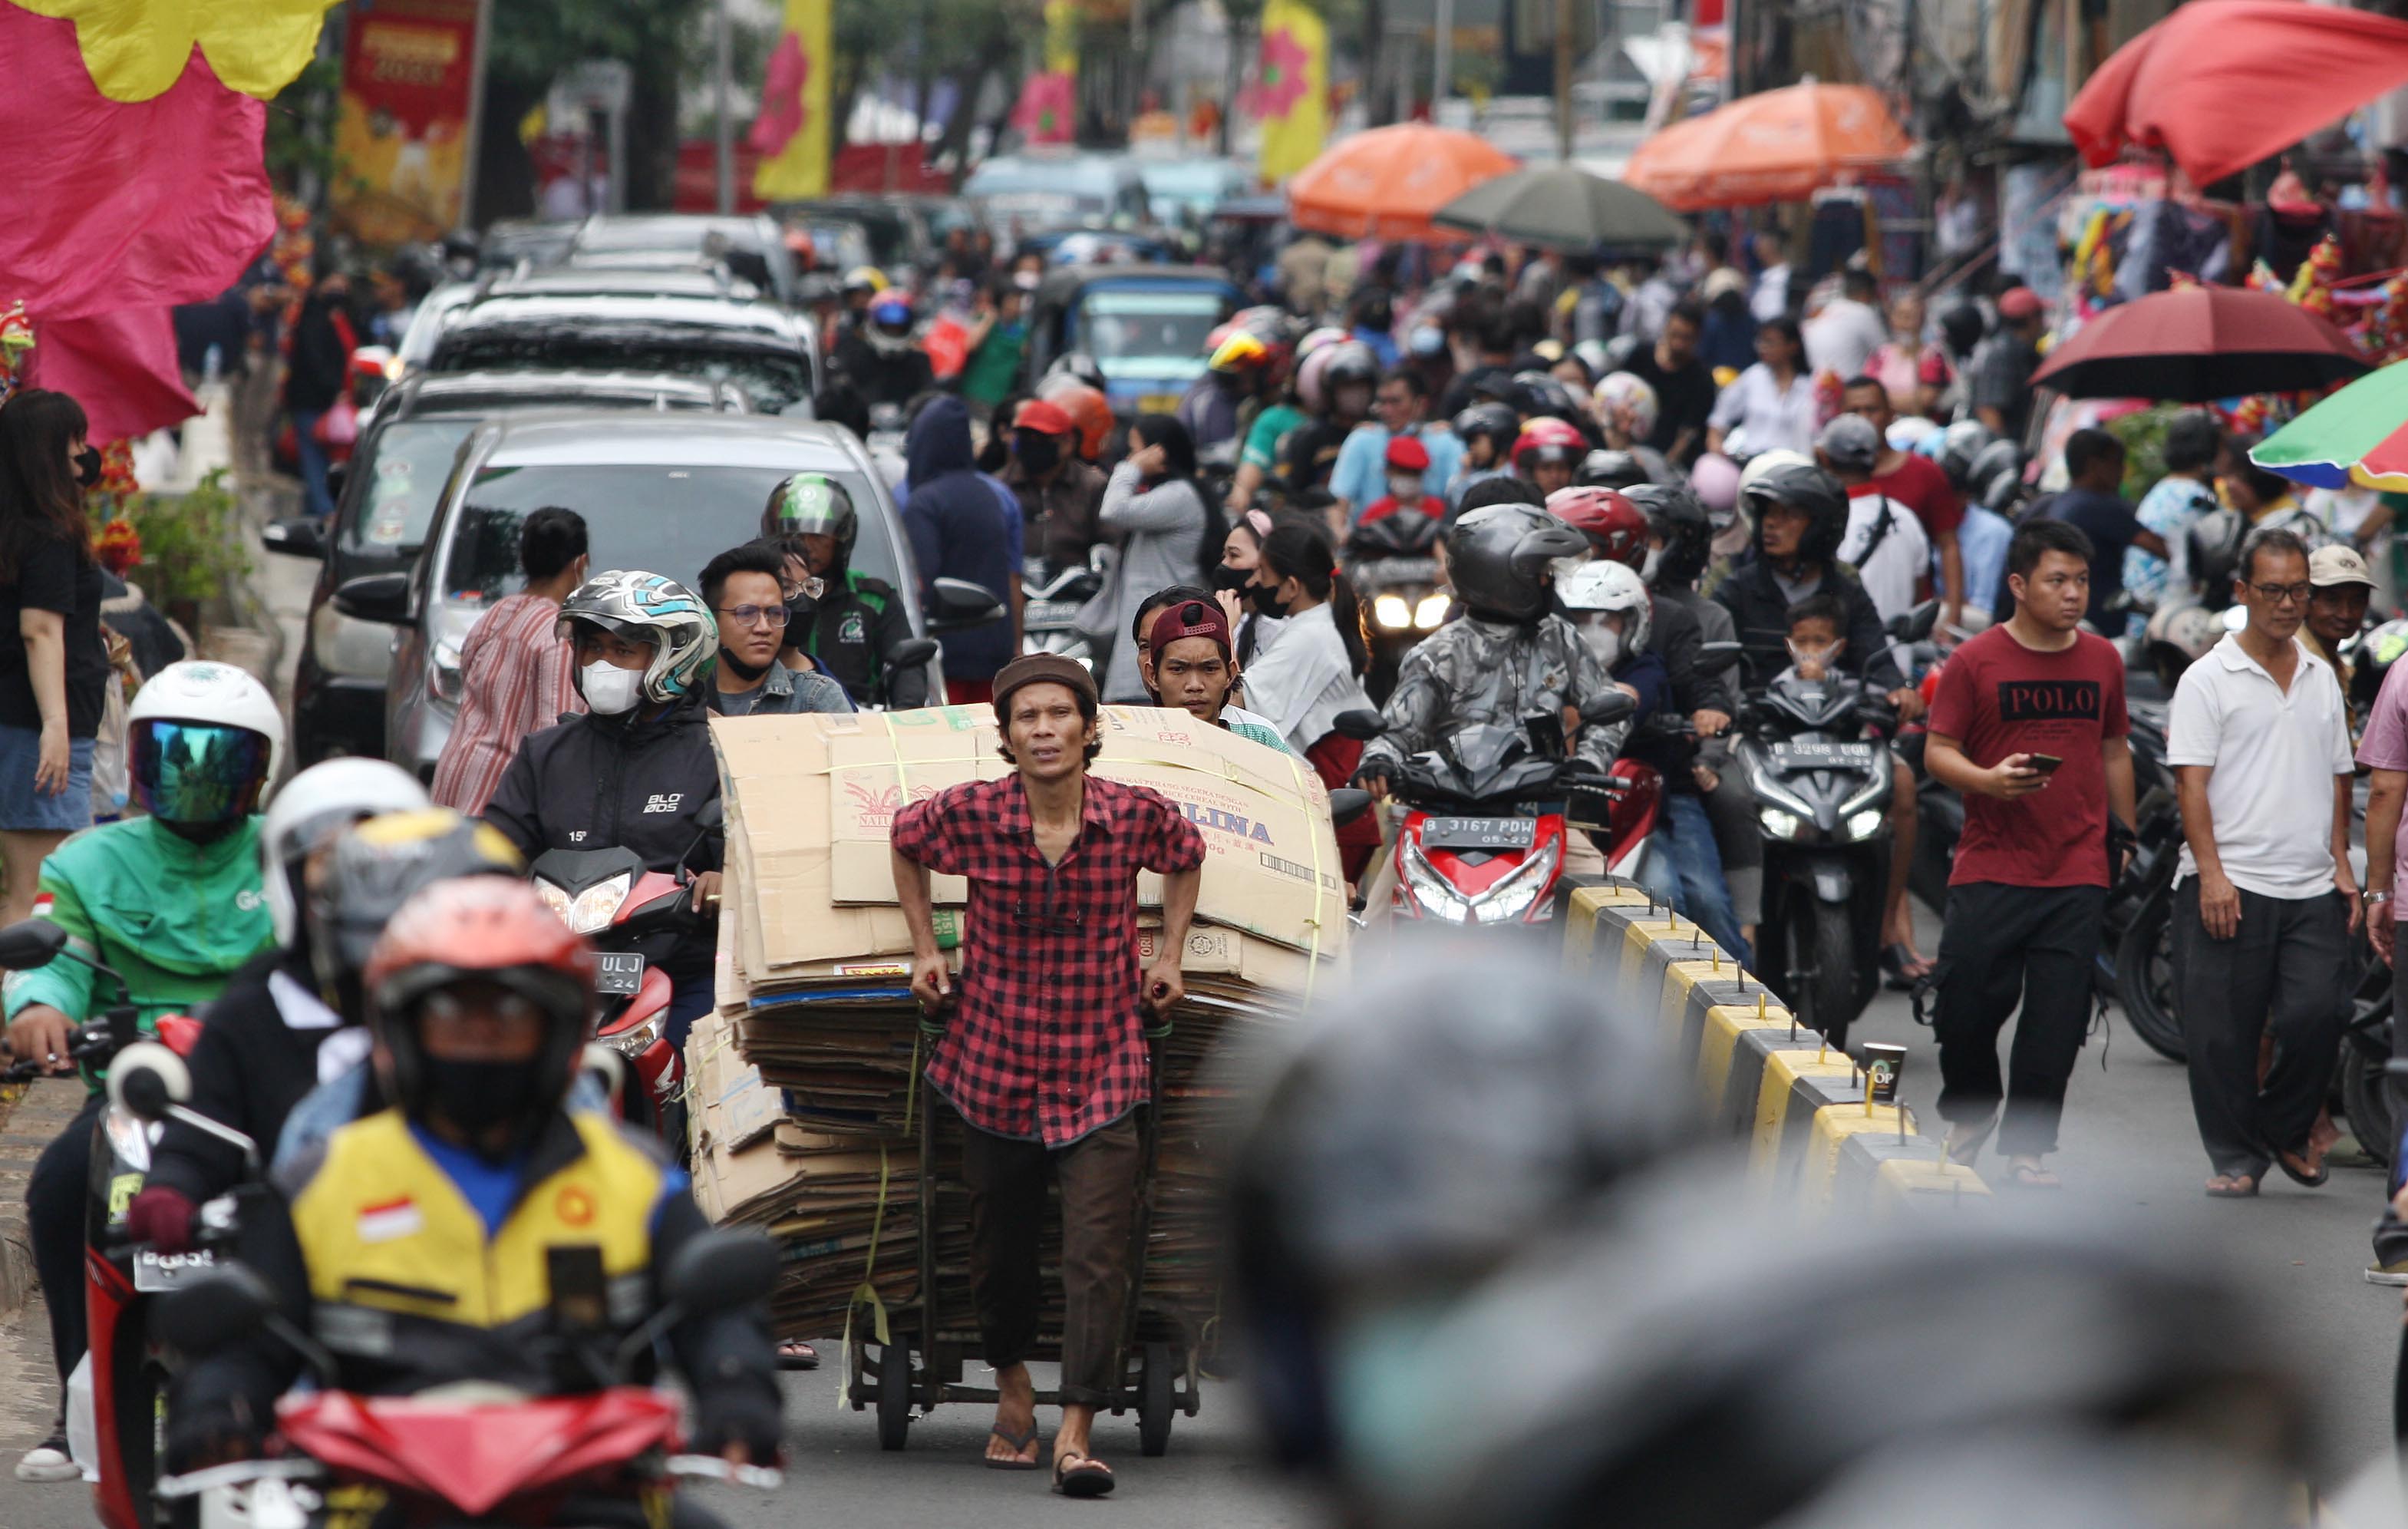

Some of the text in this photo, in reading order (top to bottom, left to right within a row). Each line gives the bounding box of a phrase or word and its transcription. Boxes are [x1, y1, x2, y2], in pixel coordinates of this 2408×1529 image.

[2011, 687, 2095, 713] POLO
[1177, 801, 1275, 847] LINA
[1427, 820, 1533, 833] B 3167 PDW
[602, 957, 640, 973] ULJ
